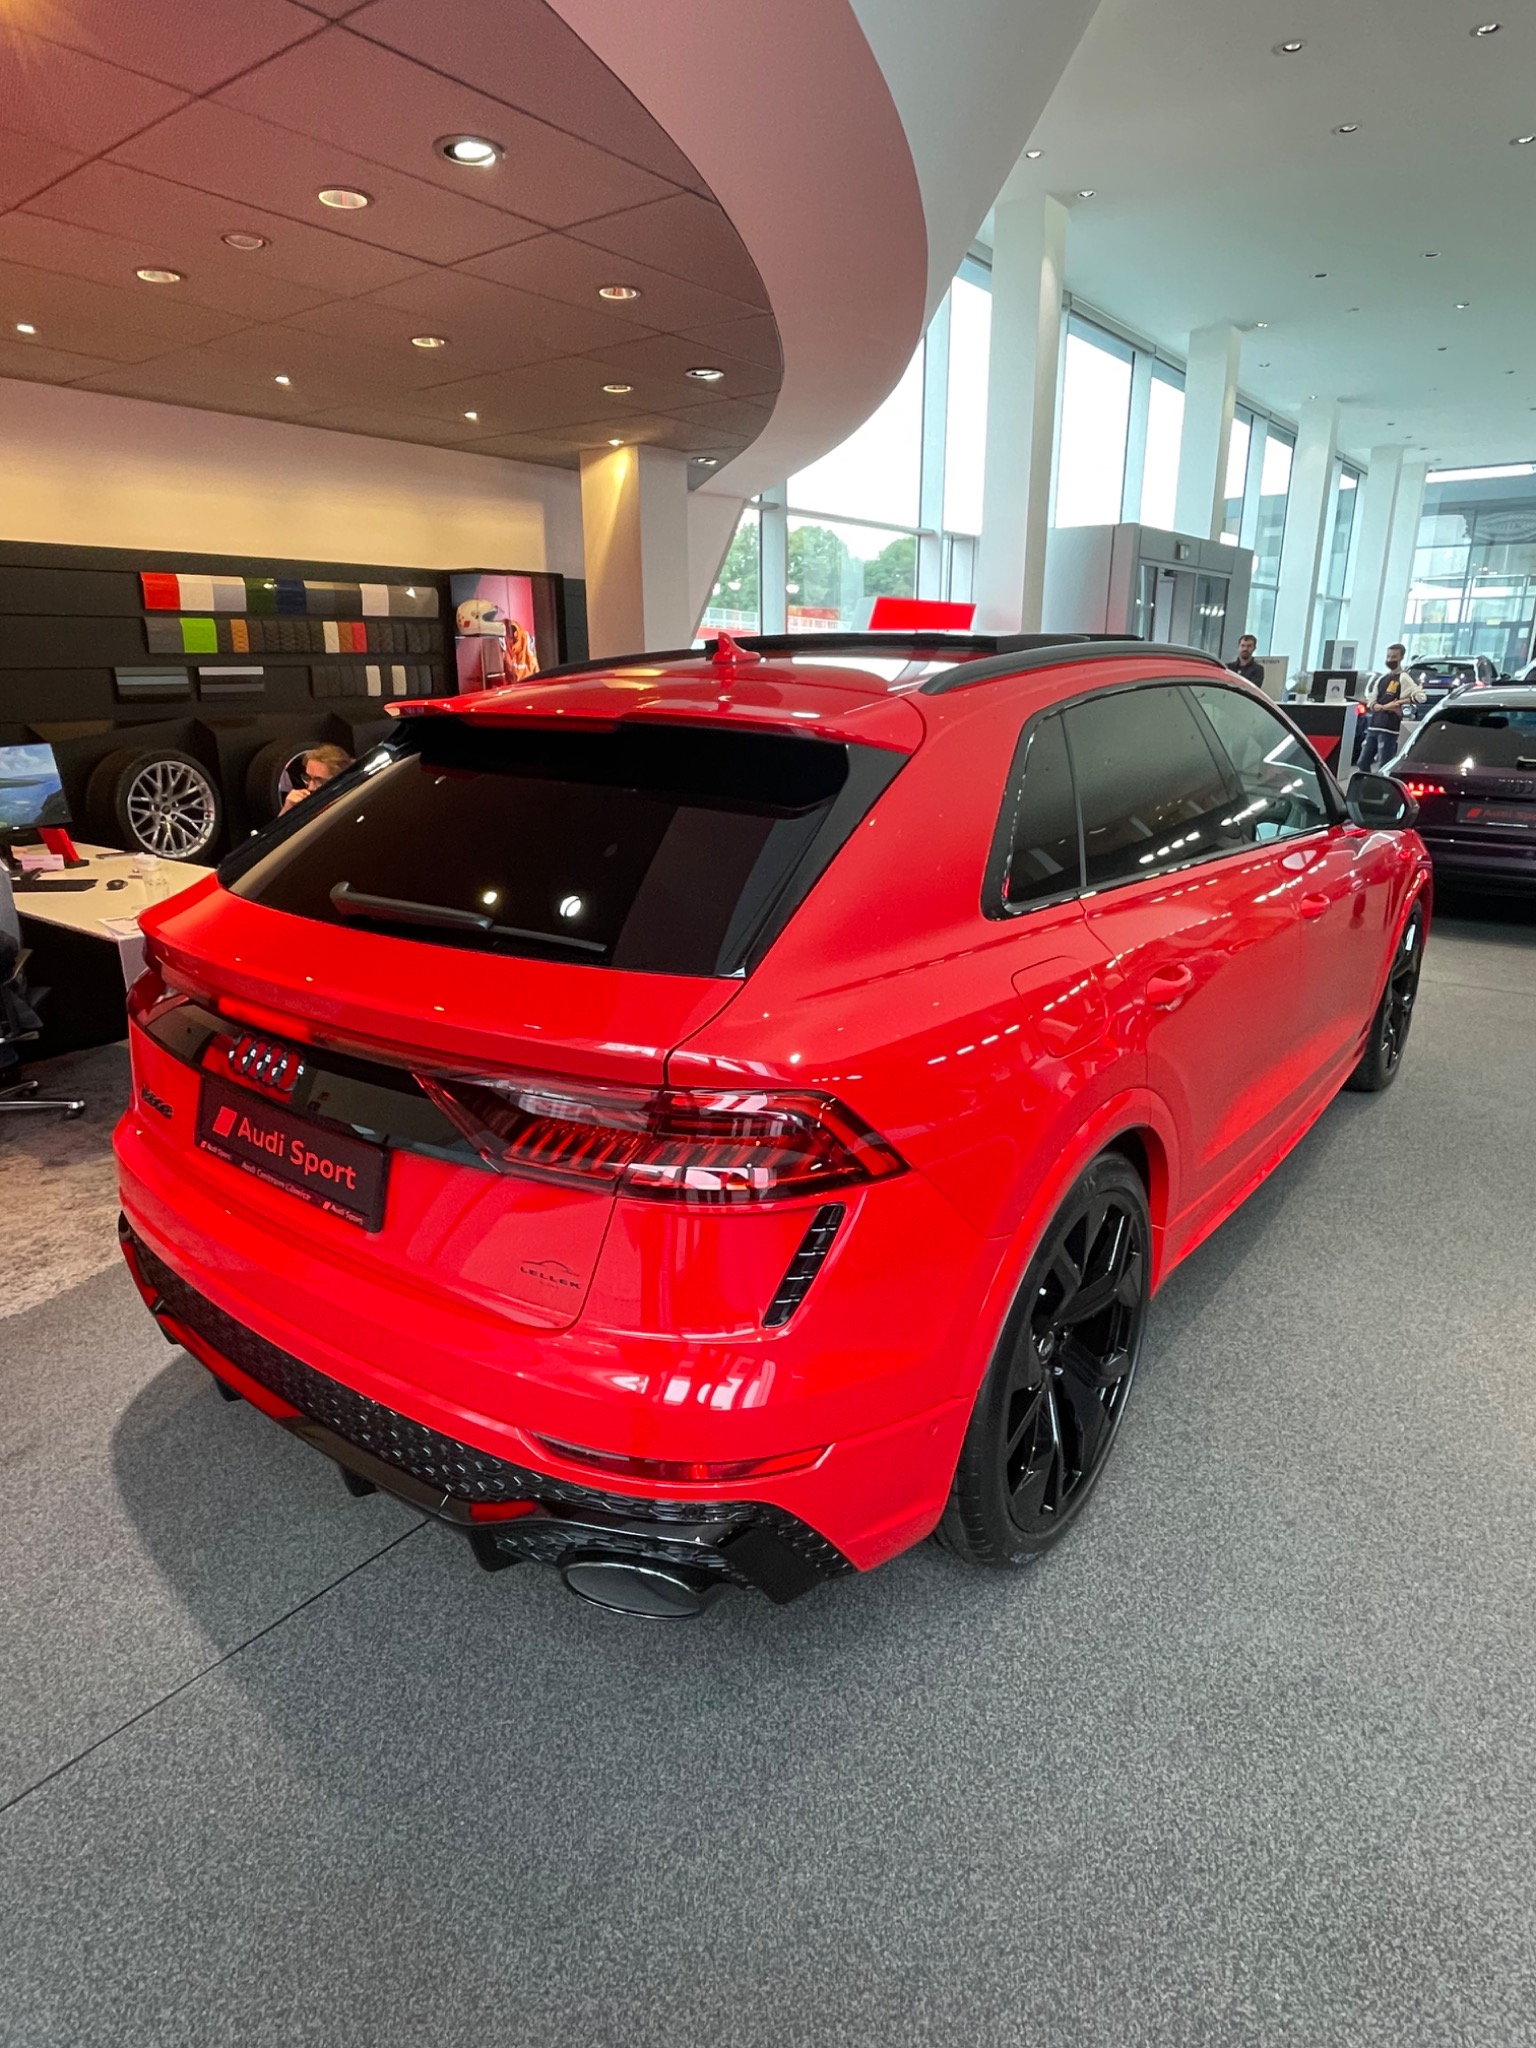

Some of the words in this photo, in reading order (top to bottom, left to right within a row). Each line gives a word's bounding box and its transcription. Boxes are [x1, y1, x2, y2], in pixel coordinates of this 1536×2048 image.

[238, 1117, 285, 1157] Audi
[290, 1140, 356, 1190] Sport
[520, 1266, 580, 1289] LELLEK
